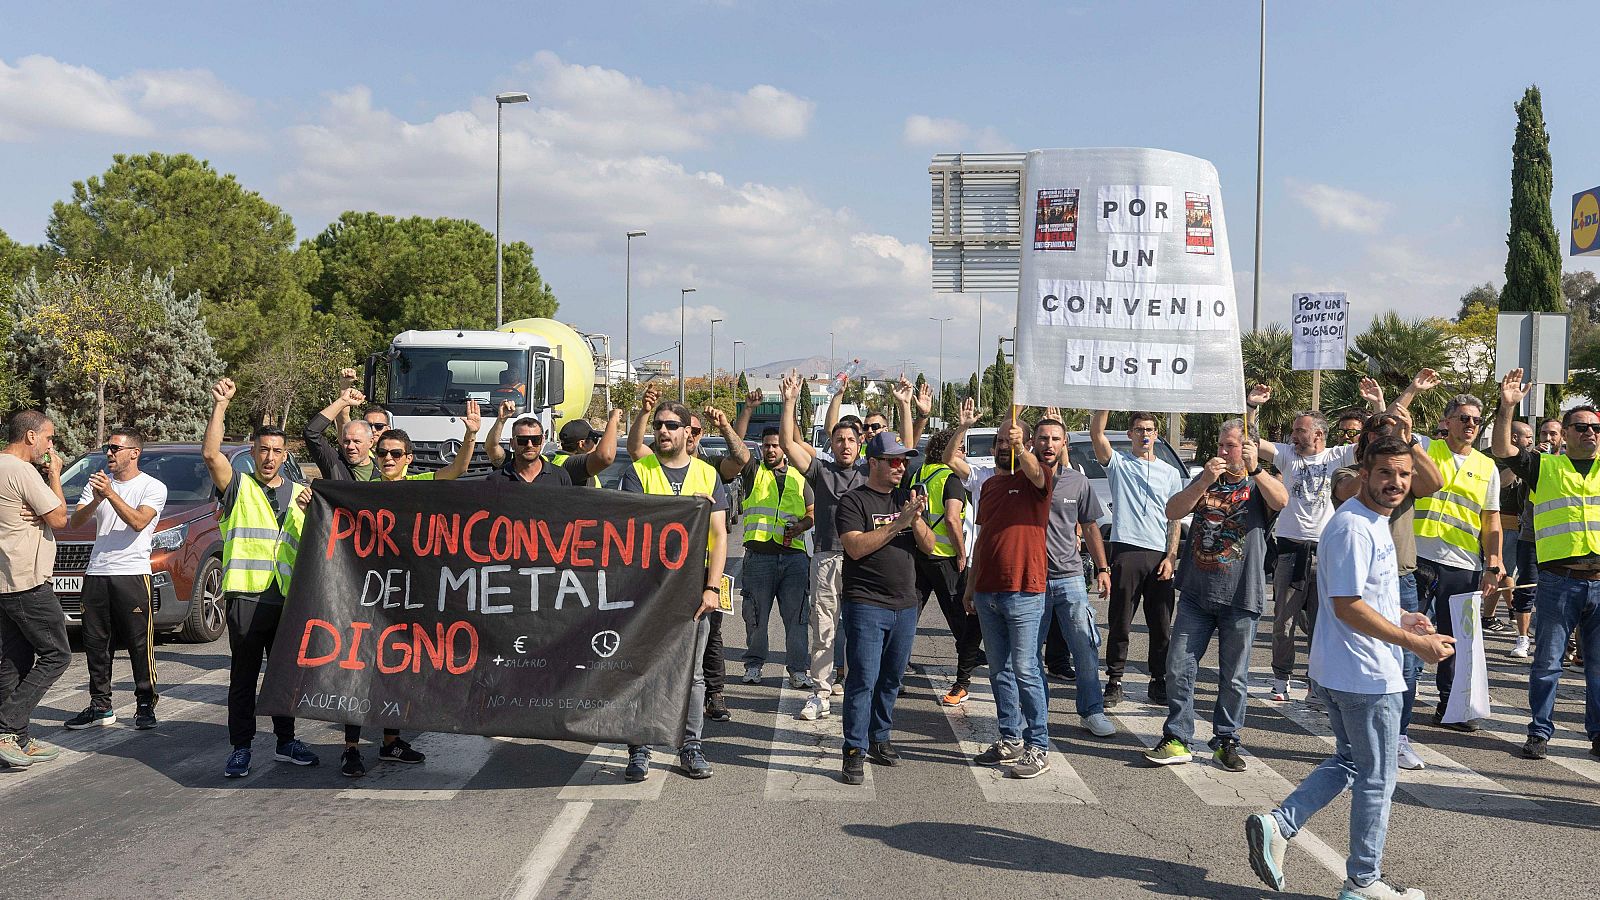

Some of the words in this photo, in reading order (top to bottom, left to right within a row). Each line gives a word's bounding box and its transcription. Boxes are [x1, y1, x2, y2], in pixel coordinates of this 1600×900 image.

[1102, 198, 1169, 219] POR
[1111, 249, 1154, 267] UN
[1041, 294, 1226, 317] CONVENIO
[1298, 296, 1321, 310] POR
[1324, 300, 1341, 310] UN
[1294, 311, 1345, 324] CONVENIO
[1302, 325, 1344, 339] DIGNO!!
[1070, 355, 1188, 376] JUSTO
[326, 507, 401, 560] POR
[55, 578, 79, 590] KHN
[360, 568, 424, 611] DEL
[437, 564, 634, 614] METAL
[296, 618, 479, 675] DIGNO
[510, 697, 524, 707] AL
[528, 698, 553, 708] PLUS
[559, 698, 574, 709] DE
